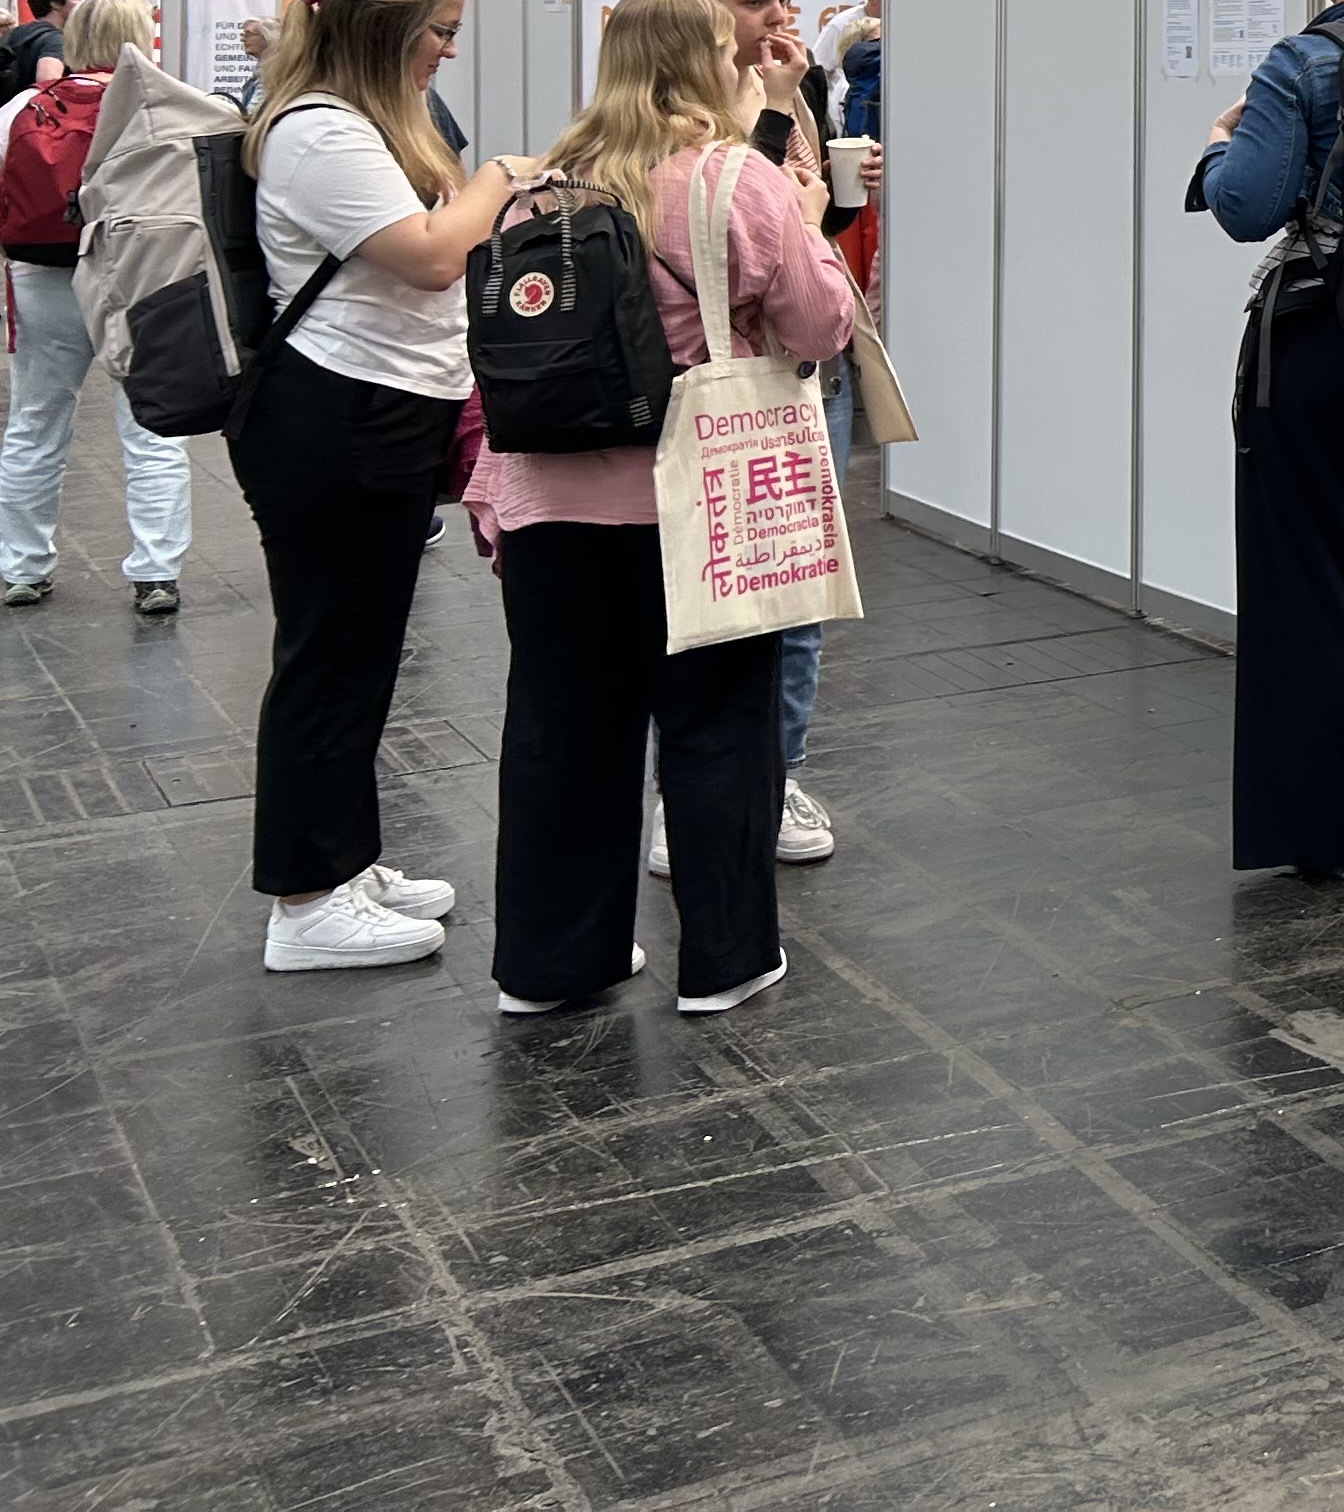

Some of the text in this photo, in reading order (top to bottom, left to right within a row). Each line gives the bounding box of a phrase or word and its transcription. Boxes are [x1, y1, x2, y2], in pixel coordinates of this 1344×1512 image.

[694, 402, 818, 441] Democracy
[745, 450, 817, 505] 民主
[746, 516, 820, 542] Democracia
[736, 557, 840, 596] Demokratie
